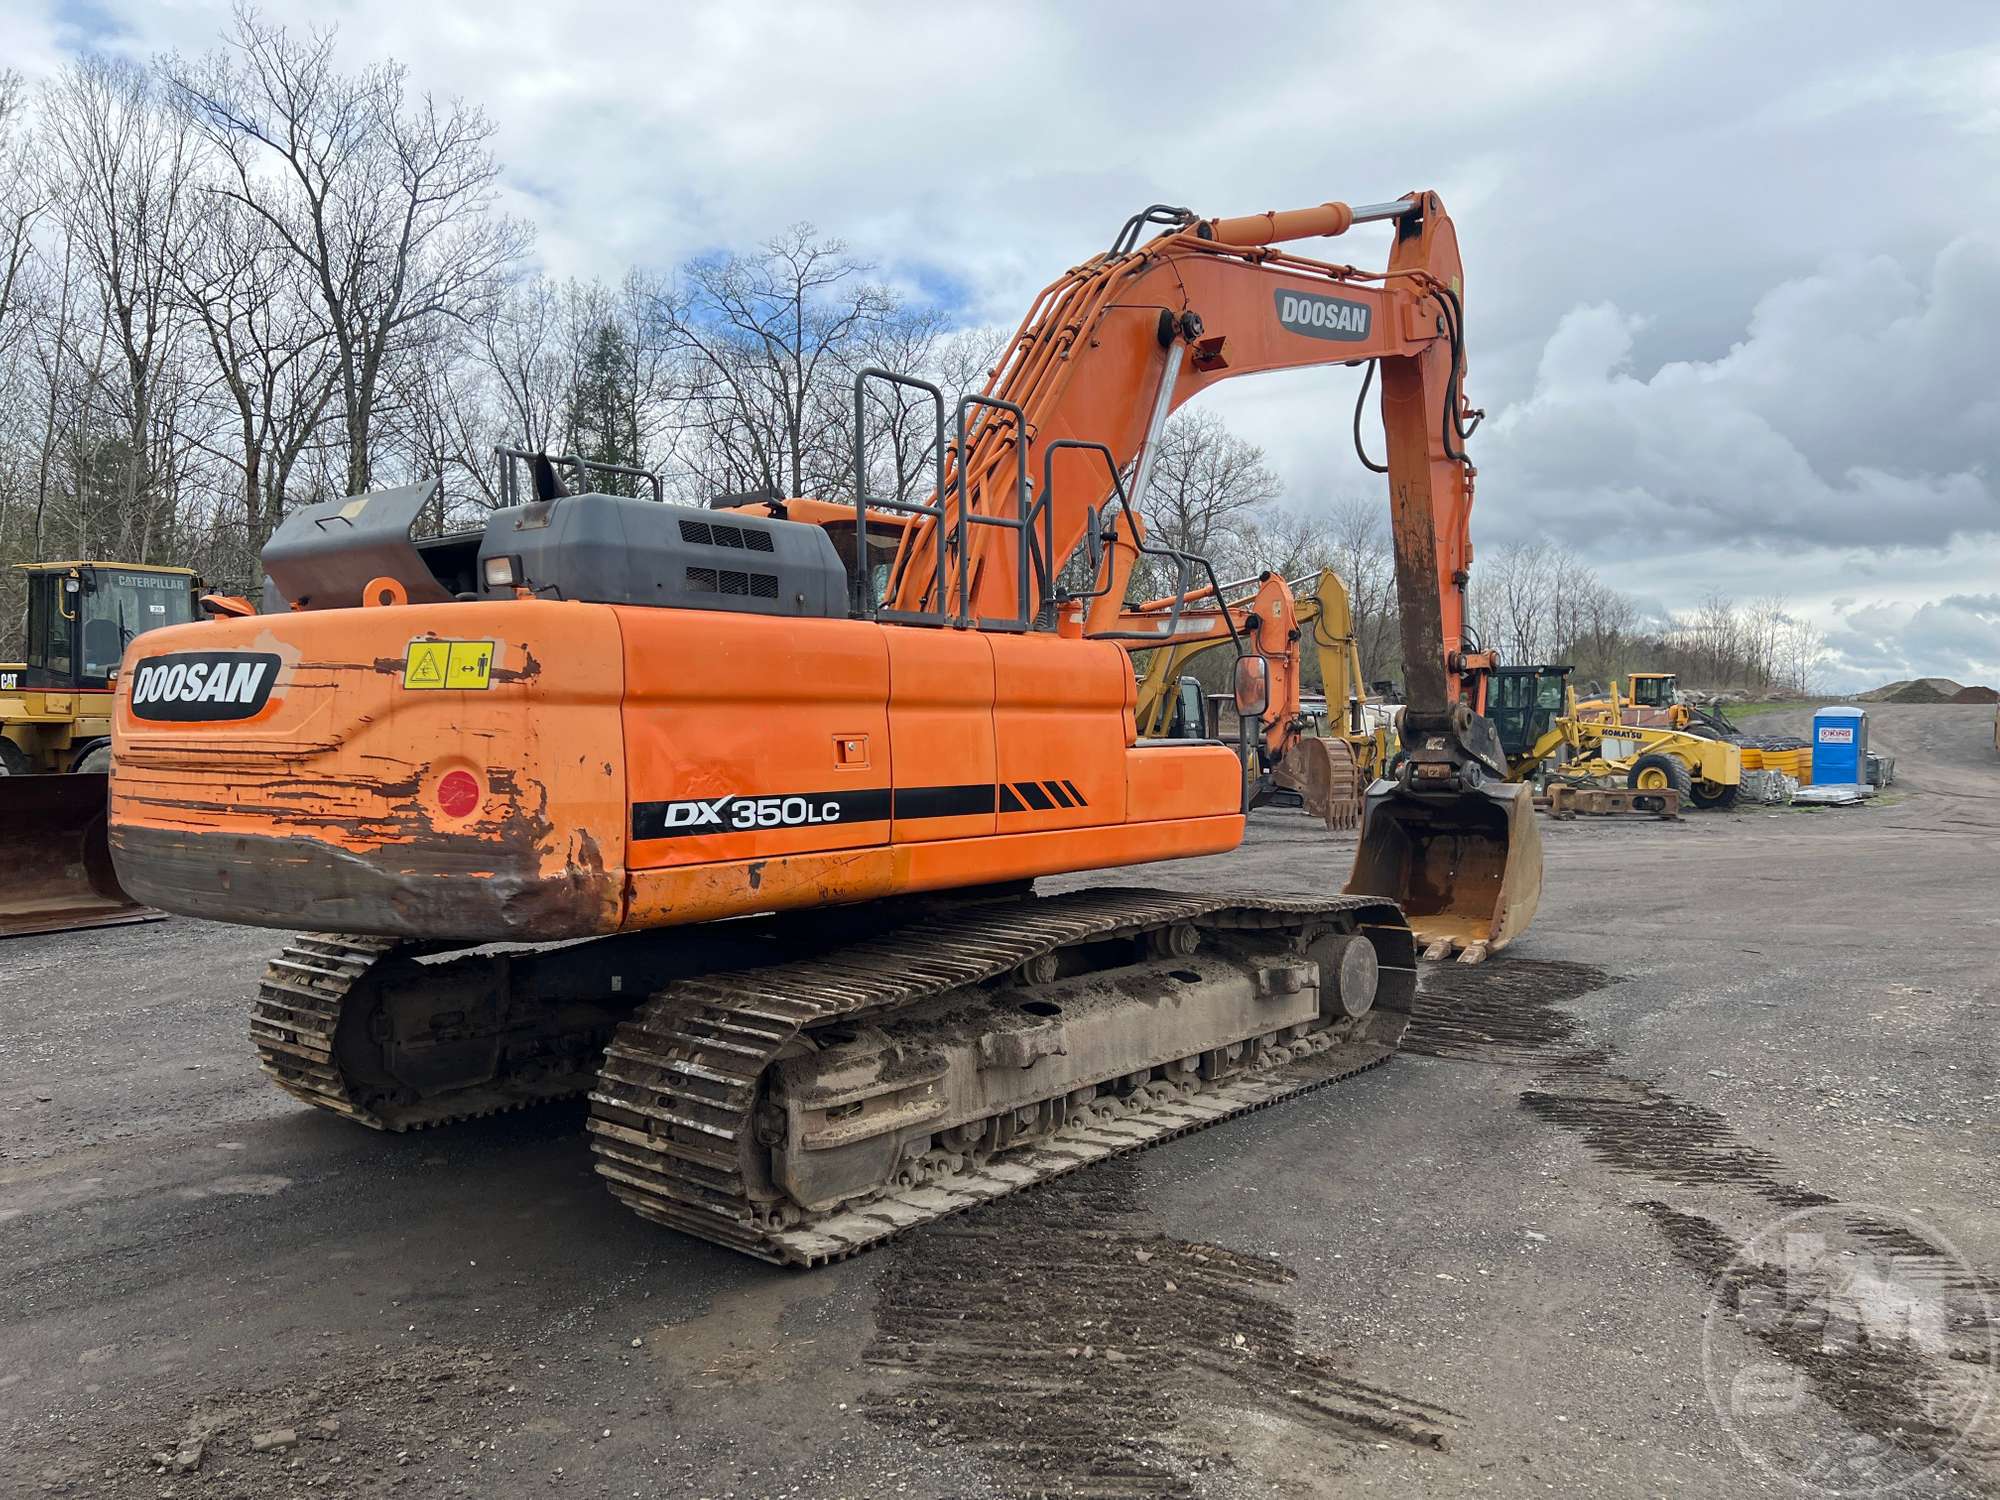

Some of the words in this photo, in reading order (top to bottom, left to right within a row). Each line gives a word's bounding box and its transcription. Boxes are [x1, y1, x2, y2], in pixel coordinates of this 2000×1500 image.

[1282, 296, 1367, 332] DOOSAN
[118, 576, 184, 590] CATERPILLAR
[1, 674, 17, 689] CAT
[133, 663, 267, 704] DOOSAN
[1601, 729, 1642, 739] KOMATSU
